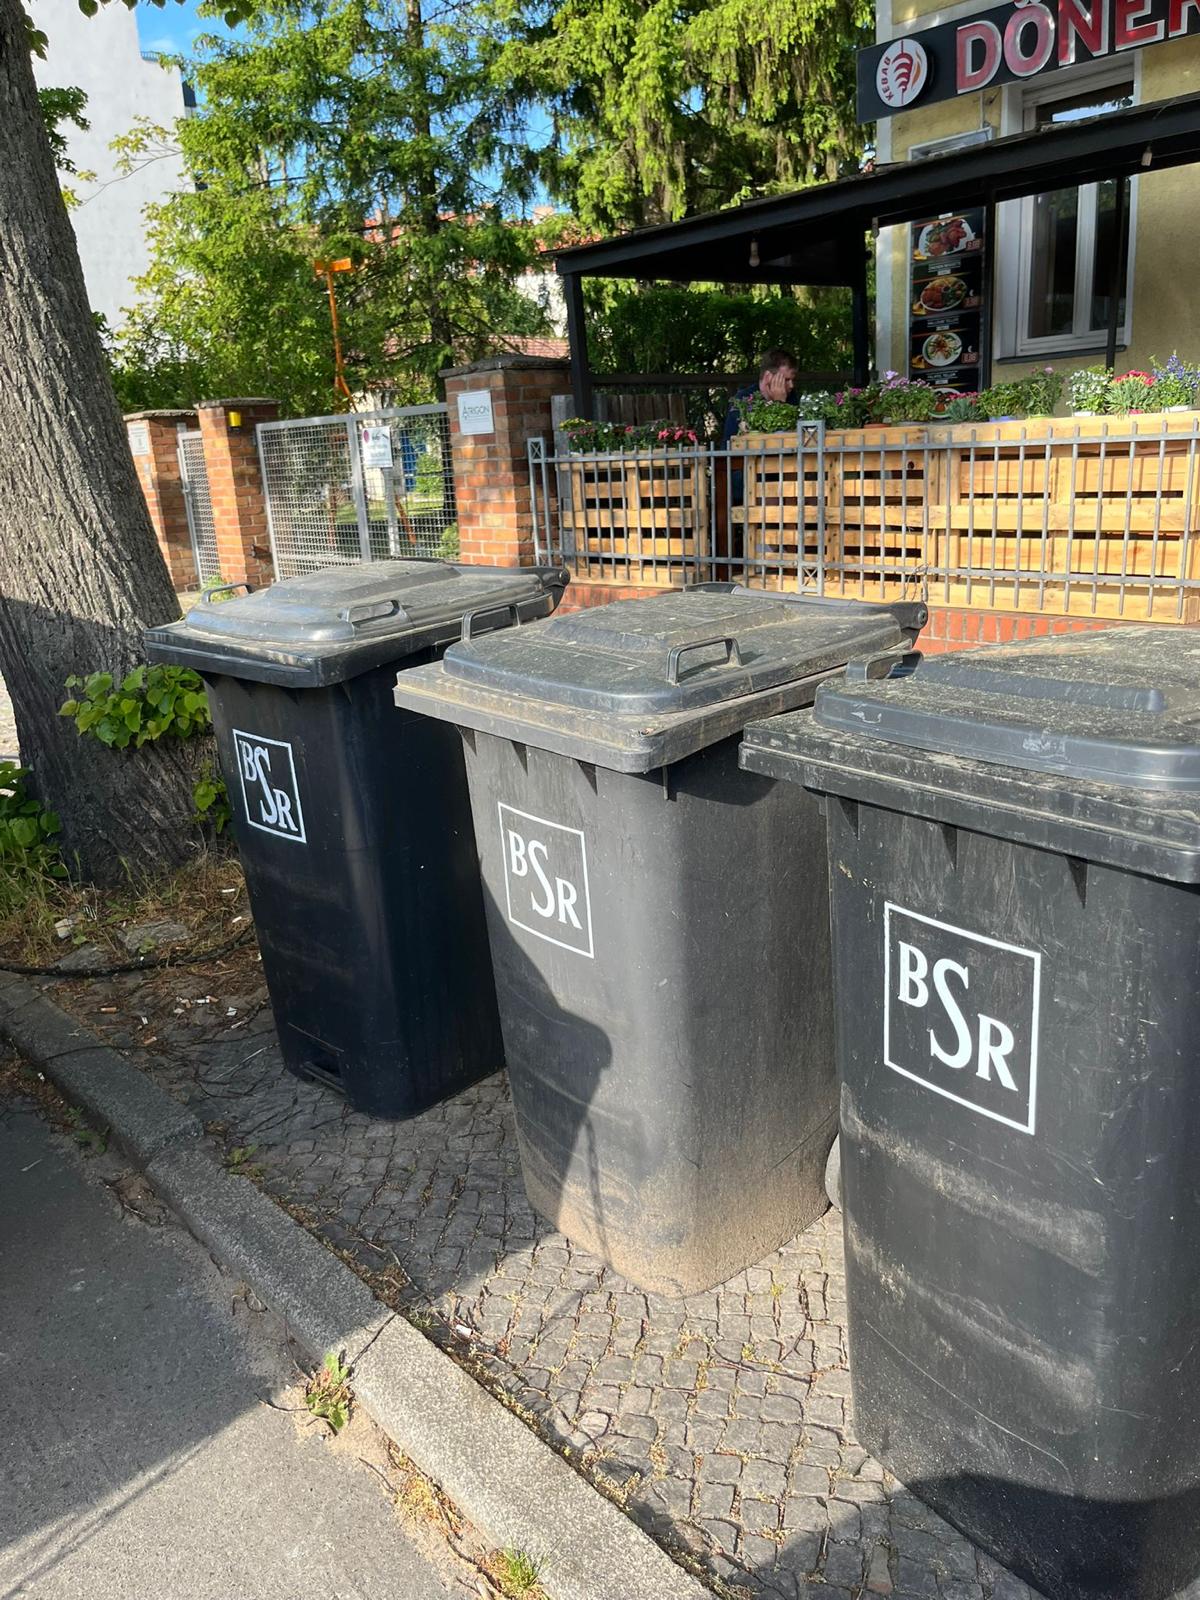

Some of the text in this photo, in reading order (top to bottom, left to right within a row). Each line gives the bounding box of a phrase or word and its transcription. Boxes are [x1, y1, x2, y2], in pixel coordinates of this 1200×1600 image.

[881, 56, 894, 101] KEBAB
[238, 740, 299, 833] BSR
[507, 830, 583, 930] BSR
[898, 941, 1018, 1092] BSR
